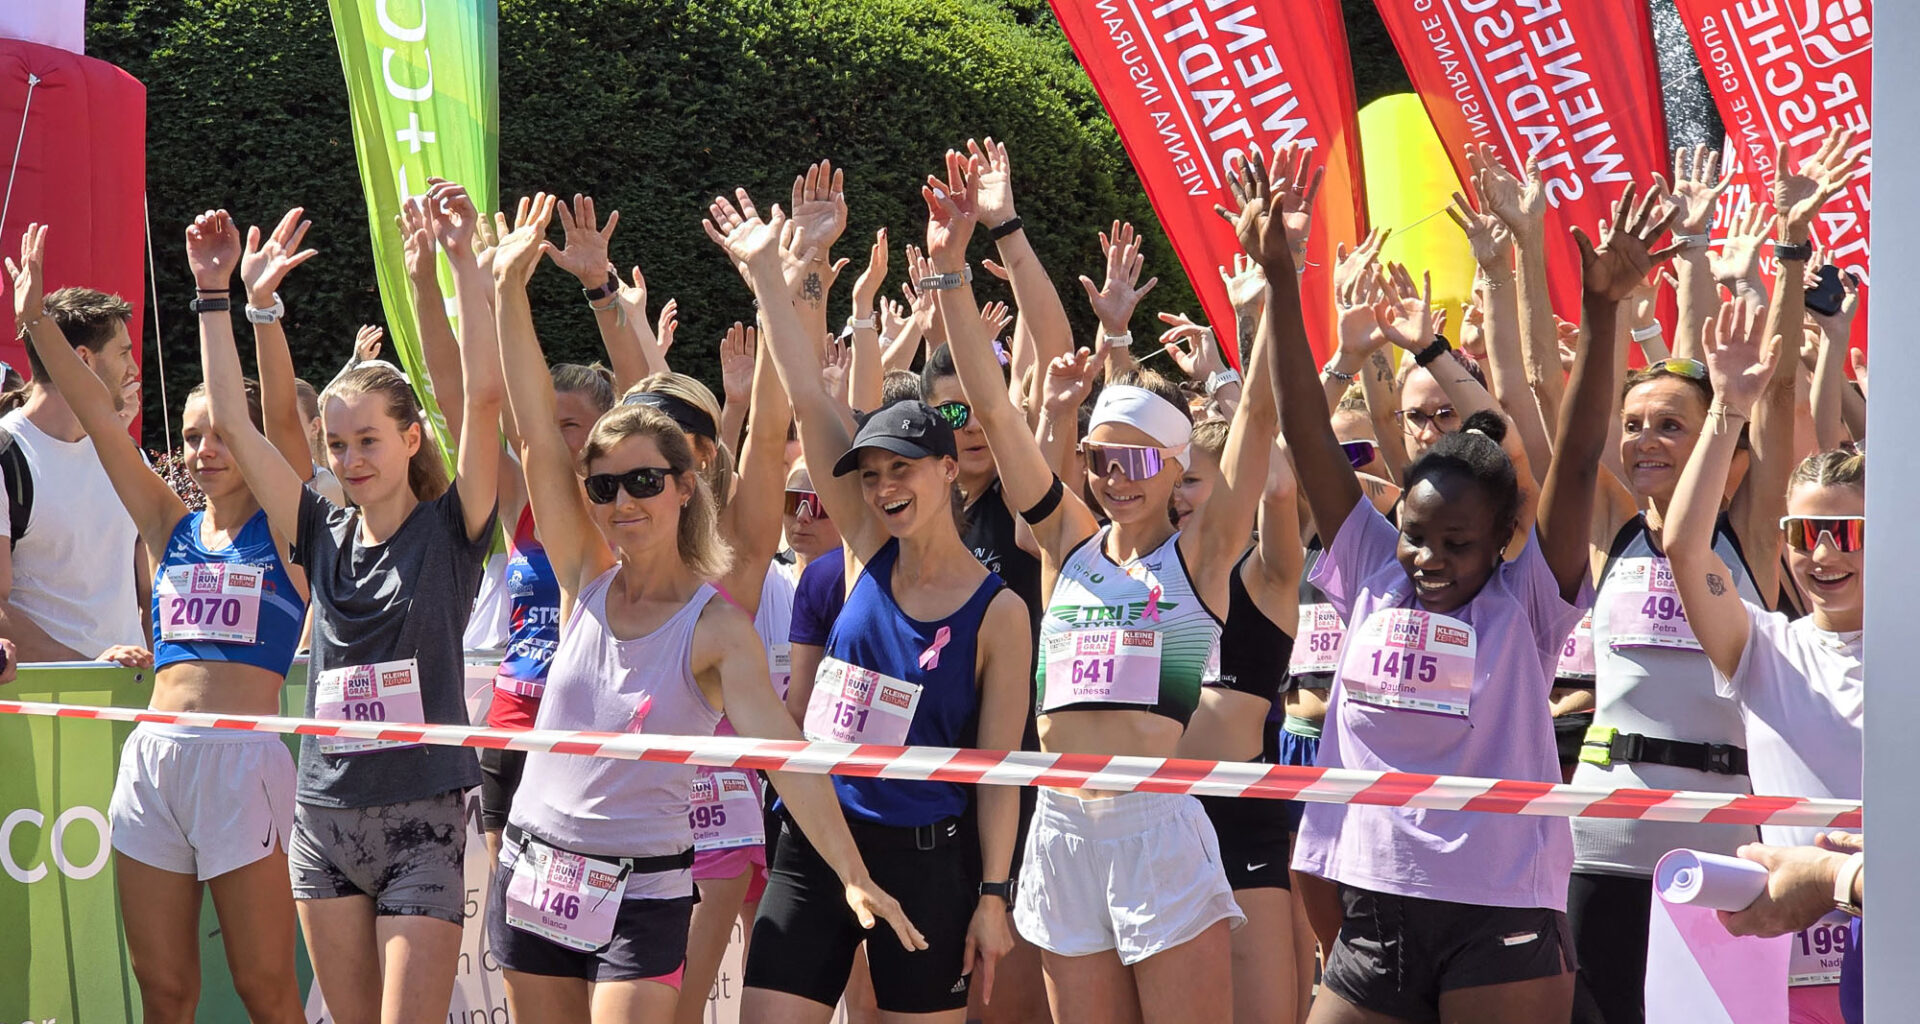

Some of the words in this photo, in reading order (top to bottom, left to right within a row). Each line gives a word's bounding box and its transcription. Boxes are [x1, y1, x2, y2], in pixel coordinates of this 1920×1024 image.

[198, 575, 218, 583] RUN
[230, 574, 256, 582] KLEINE
[171, 597, 241, 627] 2070
[1082, 605, 1124, 621] TRI
[1318, 613, 1336, 621] RUN
[1071, 620, 1136, 629] STYRIA
[1394, 623, 1420, 635] RUN
[1652, 622, 1678, 633] Petra
[1124, 630, 1154, 639] KLEINE
[1437, 626, 1468, 638] KLEINE
[1084, 634, 1109, 643] RUN
[1123, 638, 1153, 647] ZEITUNG
[1310, 632, 1342, 652] 587
[1393, 634, 1418, 643] GRAZ
[1435, 634, 1468, 646] ZEITUNG
[1071, 658, 1115, 684] 641
[1371, 649, 1438, 683] 1415
[383, 671, 410, 680] KLEINE
[348, 678, 370, 688] RUN
[847, 678, 869, 692] RUN
[348, 687, 370, 696] GRAZ
[883, 687, 911, 700] KLEINE
[1073, 687, 1110, 696] Vanessa
[881, 694, 909, 707] ZEITUNG
[342, 701, 386, 723] 180
[833, 701, 869, 733] 151
[0, 805, 111, 884] CO
[555, 864, 577, 878] RUN
[553, 873, 576, 885] GRAZ
[540, 888, 580, 921] 146
[541, 915, 568, 931] Bianca
